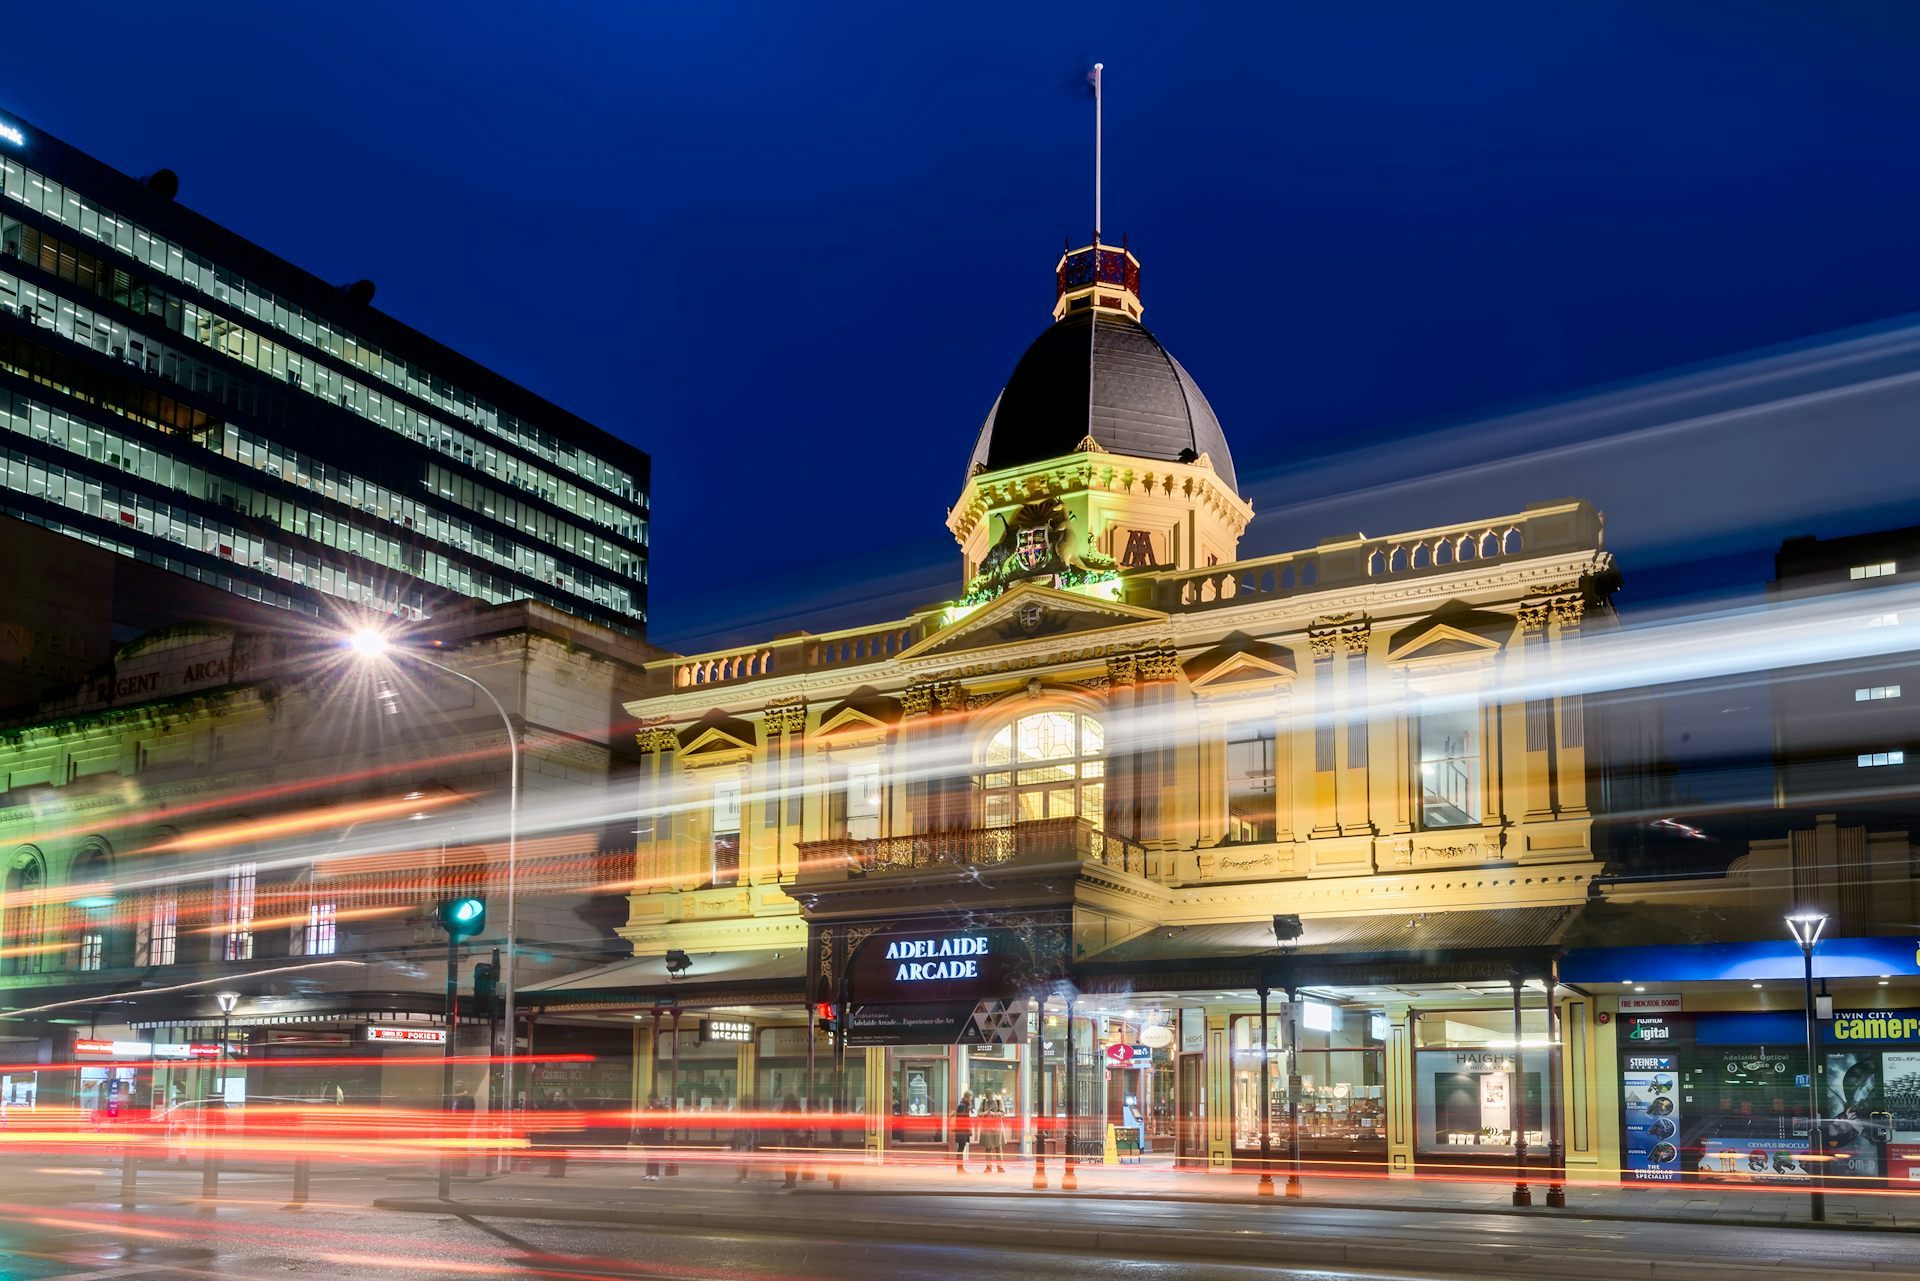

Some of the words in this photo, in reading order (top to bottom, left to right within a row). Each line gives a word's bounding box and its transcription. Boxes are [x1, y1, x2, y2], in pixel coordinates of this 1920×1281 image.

[183, 653, 250, 683] ARCADE
[885, 937, 989, 959] ADELAIDE
[895, 960, 978, 981] ARCADE
[711, 1021, 751, 1031] GERARD
[408, 1032, 437, 1040] POKIES
[1630, 1023, 1669, 1040] digital
[1456, 1053, 1516, 1064] HAIGH'S
[1630, 1057, 1659, 1067] STEINER
[1760, 1054, 1790, 1062] Optical
[1748, 1141, 1777, 1149] OLYMPUS
